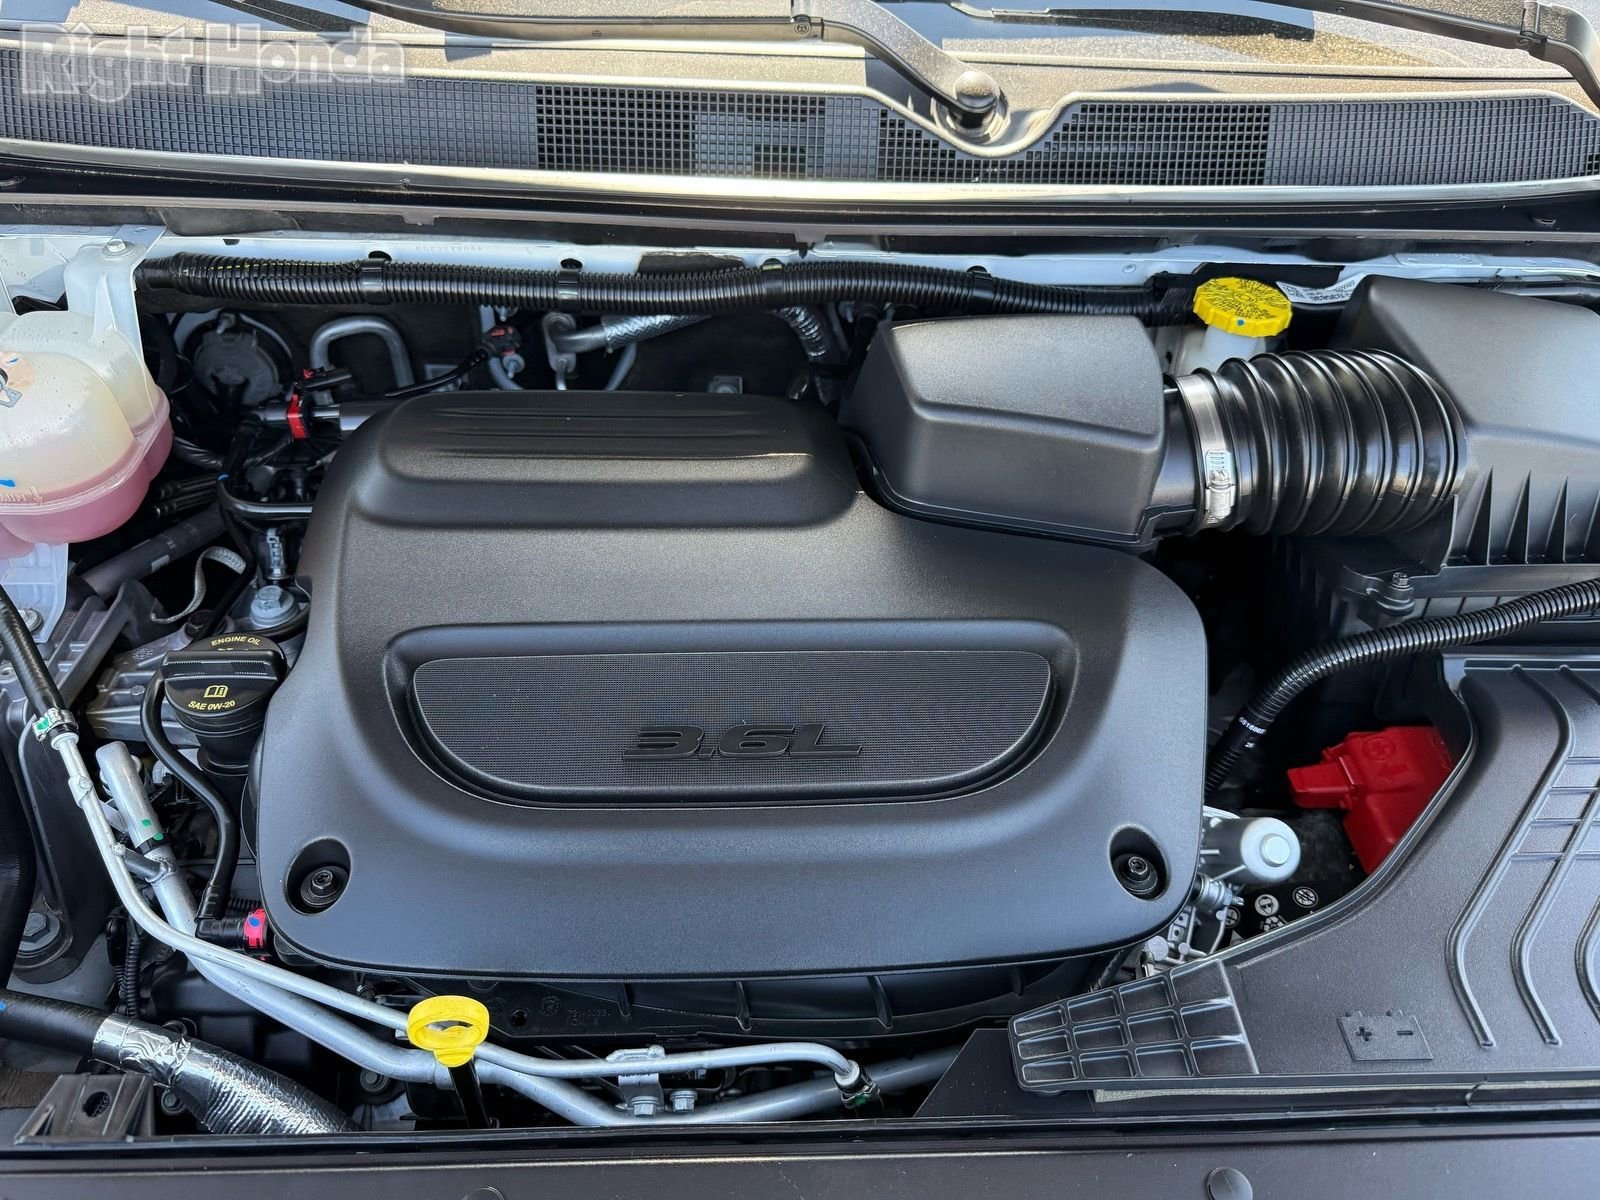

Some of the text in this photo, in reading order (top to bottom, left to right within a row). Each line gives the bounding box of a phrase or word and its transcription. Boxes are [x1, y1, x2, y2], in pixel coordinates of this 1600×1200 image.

[211, 636, 261, 646] ENGINE OIL
[188, 700, 236, 711] SAE 0W-20
[622, 723, 862, 761] 3.6L
